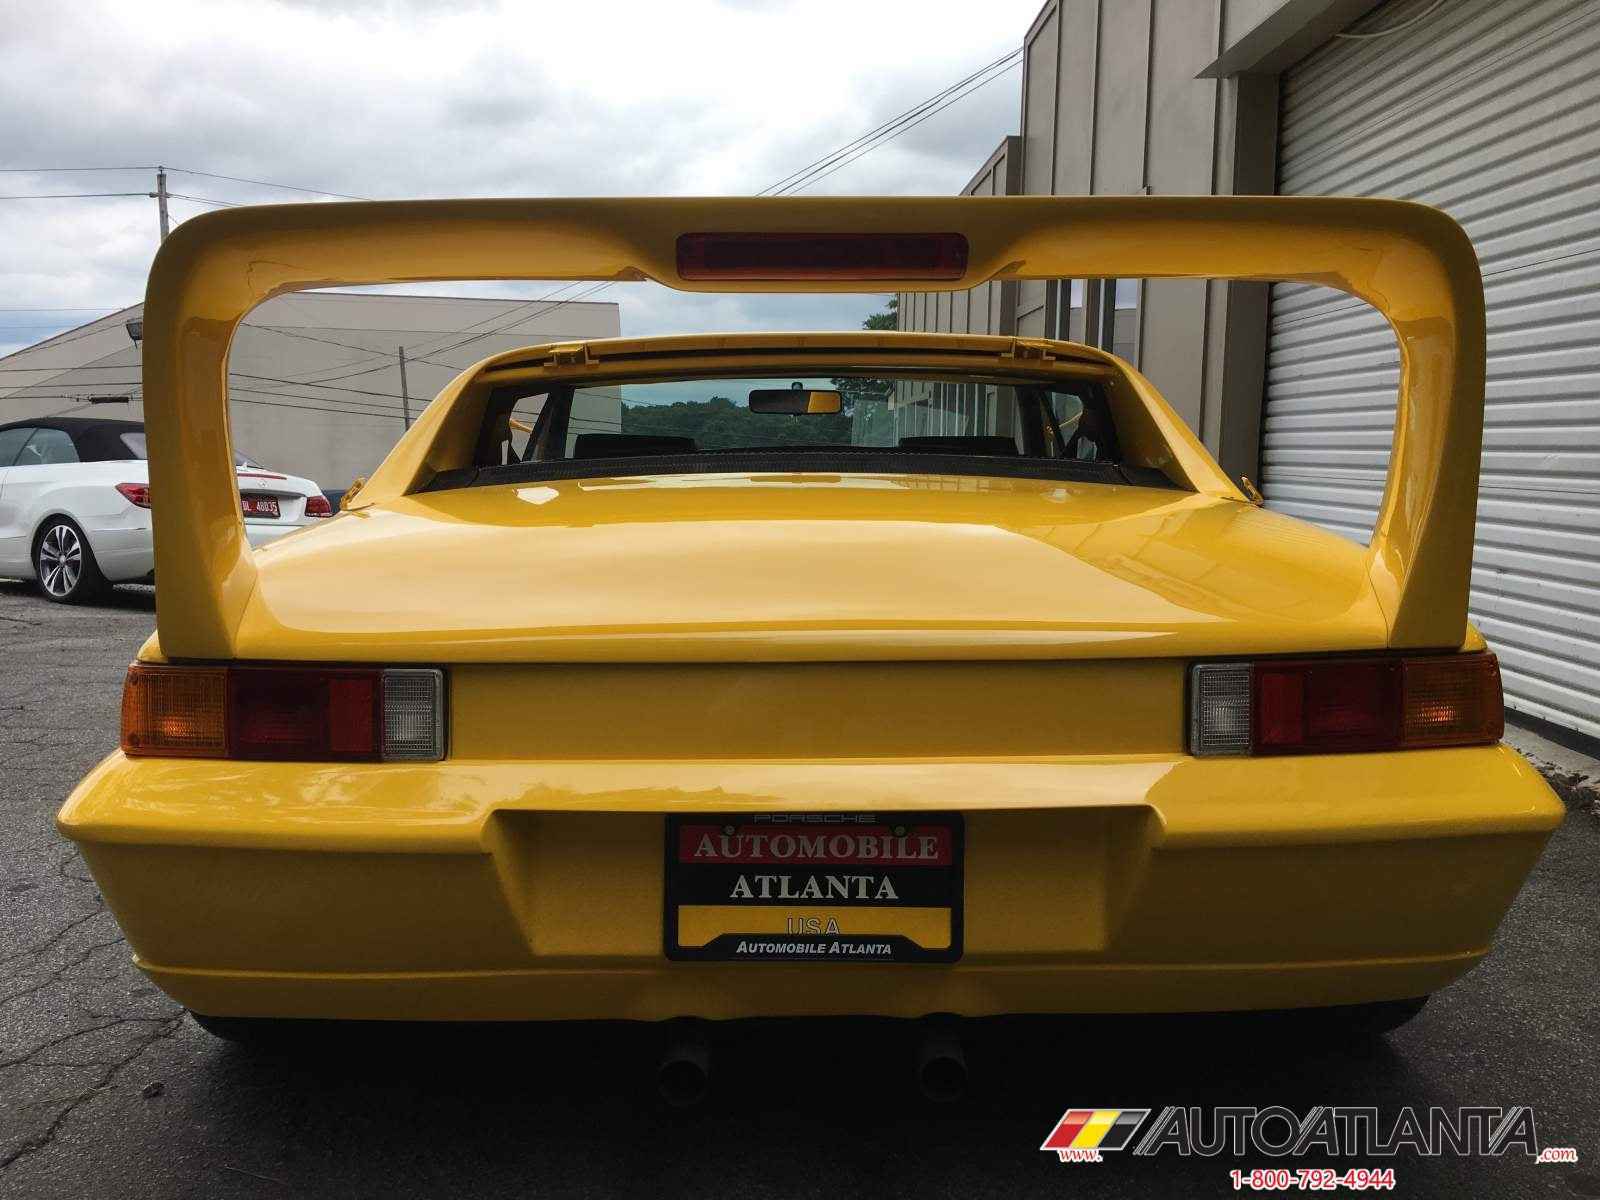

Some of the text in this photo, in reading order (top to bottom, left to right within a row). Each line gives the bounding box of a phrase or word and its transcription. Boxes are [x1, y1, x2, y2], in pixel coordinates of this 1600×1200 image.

[752, 814, 876, 825] PORSCHE
[694, 832, 939, 860] AUTOMOBILE
[729, 874, 899, 900] ATLANTA
[786, 917, 840, 935] USA
[736, 940, 892, 955] AUTOMOBILE ATLANTA
